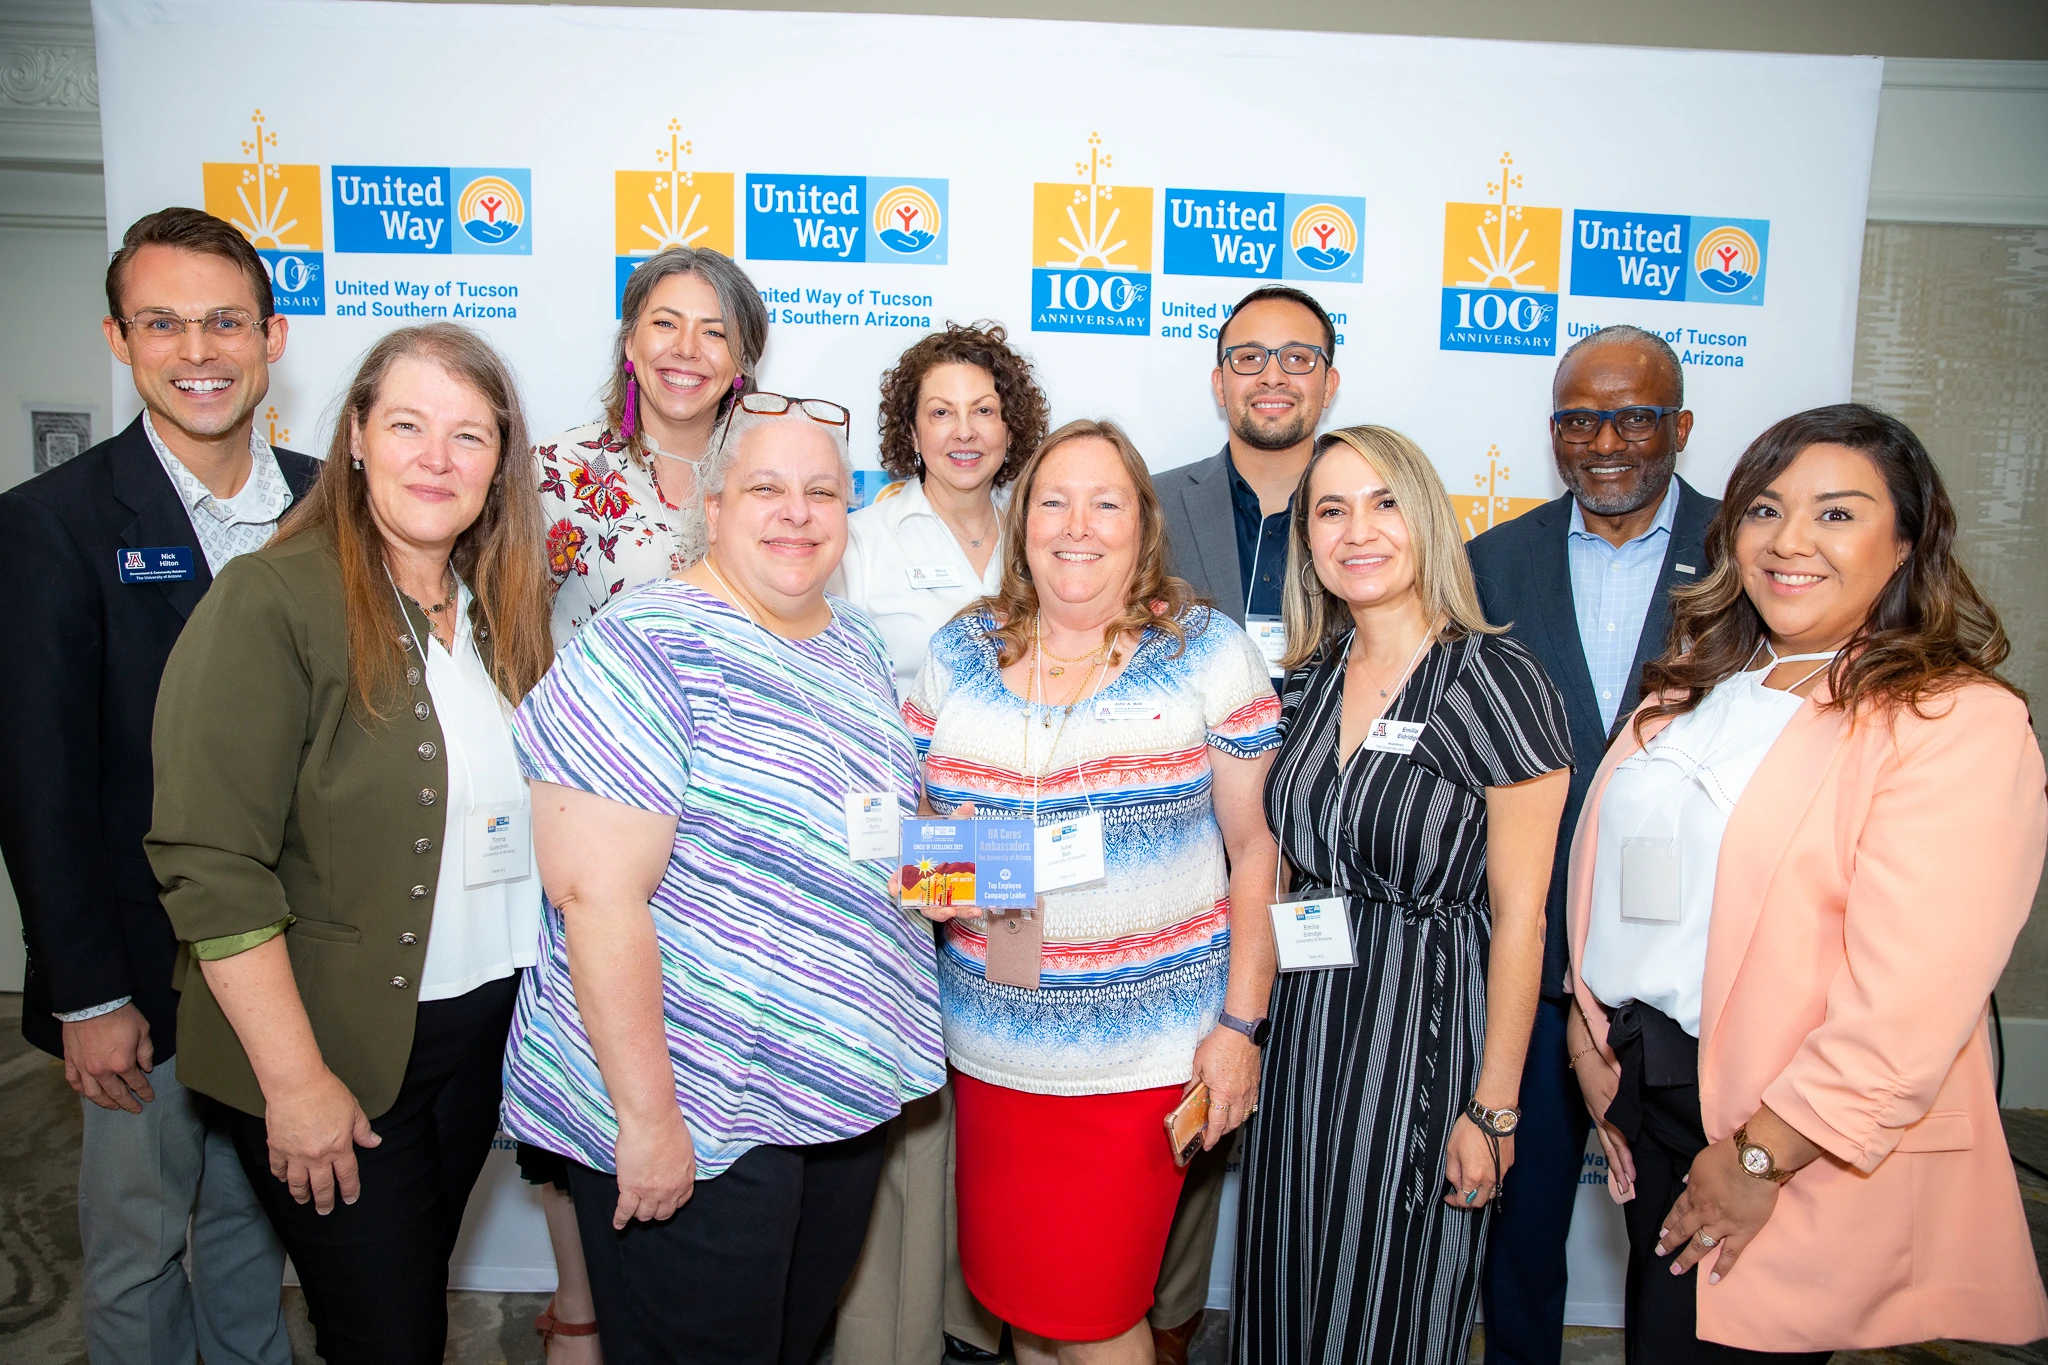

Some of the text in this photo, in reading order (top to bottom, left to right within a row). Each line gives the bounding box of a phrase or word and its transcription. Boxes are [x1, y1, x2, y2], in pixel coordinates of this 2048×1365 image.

[337, 174, 444, 207] United
[751, 183, 860, 215] United
[1171, 198, 1277, 232] United
[380, 210, 444, 250] Way
[793, 218, 858, 257] Way
[1578, 219, 1682, 254] United
[1211, 234, 1276, 274] Way
[1617, 256, 1680, 296] Way
[335, 280, 518, 301] United Way of Tucson
[758, 288, 933, 308] nited Way of Tucson
[336, 302, 517, 319] and Southern Arizona
[782, 309, 859, 326] Southern
[865, 312, 930, 328] Arizona
[1162, 301, 1216, 318] United
[1038, 313, 1146, 328] ANNIVERSARY
[1161, 323, 1192, 338] and
[1446, 331, 1552, 348] ANNIVERSARY
[1567, 322, 1600, 338] Unit
[1665, 328, 1683, 343] of
[1687, 330, 1747, 347] Tucson
[1681, 350, 1744, 367] Arizona
[1373, 723, 1386, 736] A
[988, 828, 1022, 839] UA Cares
[980, 841, 1030, 851] Ambassadors
[998, 882, 1022, 890] Employee
[984, 892, 1008, 900] Campaign
